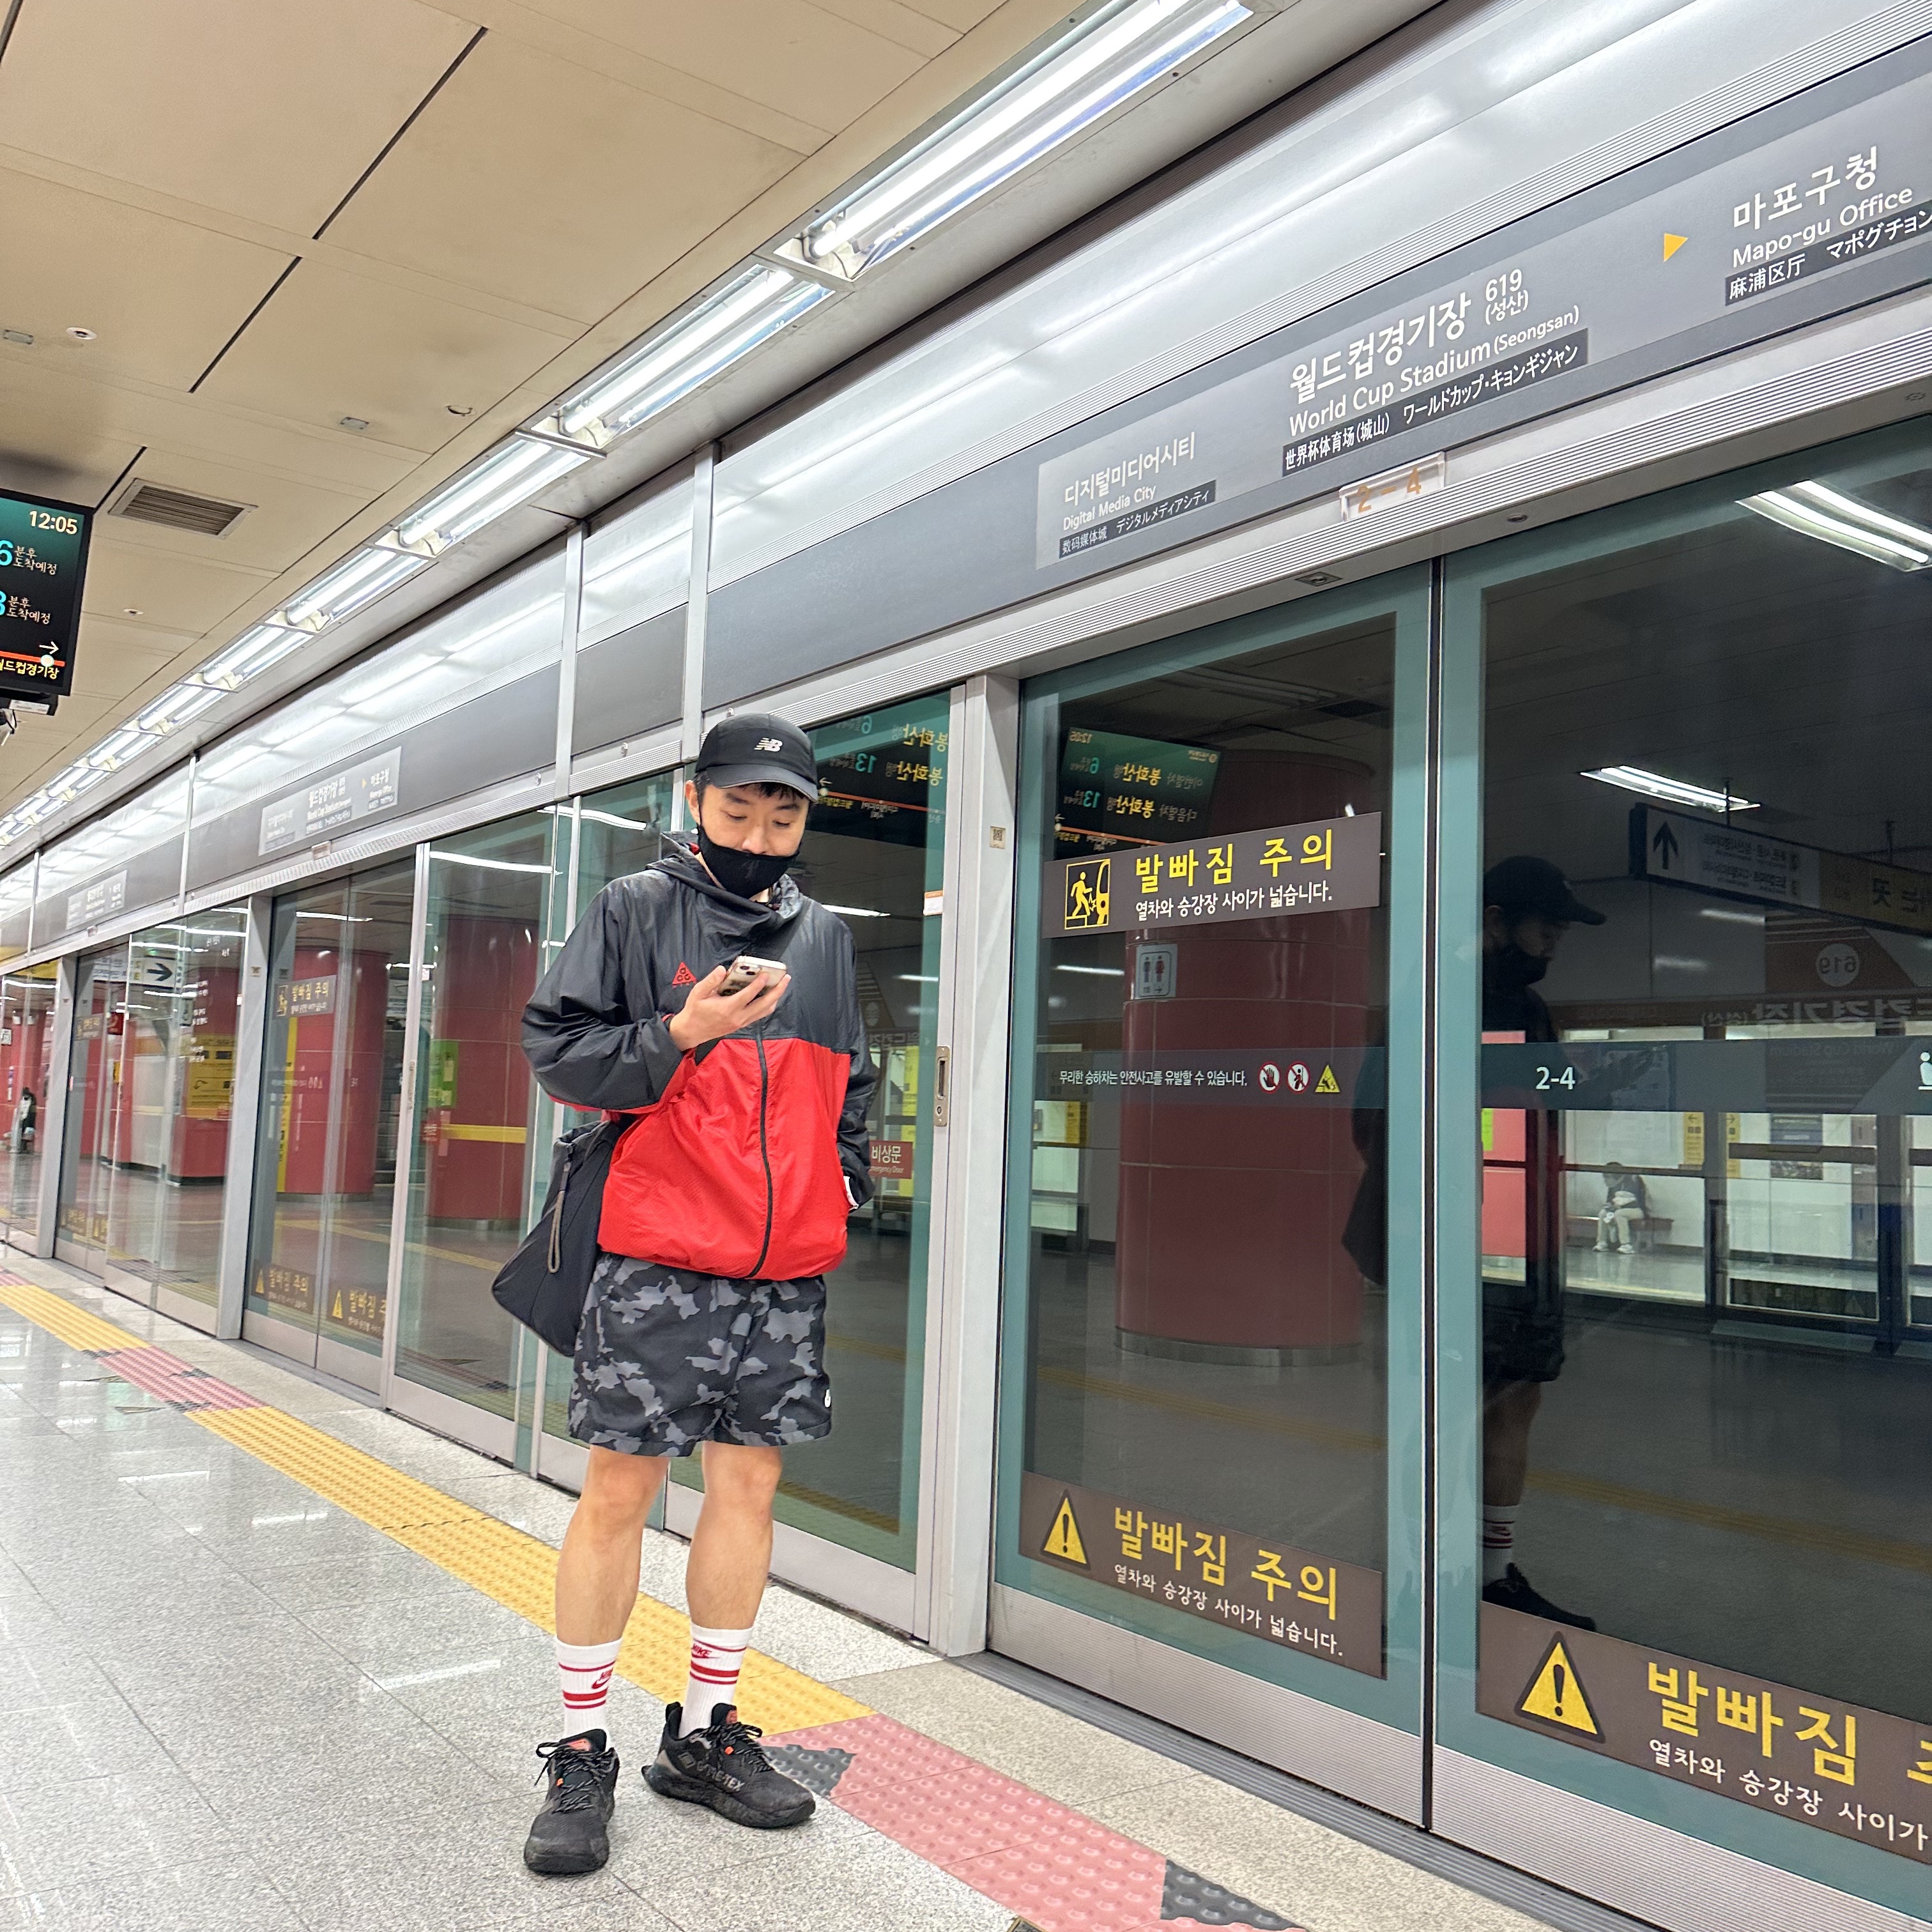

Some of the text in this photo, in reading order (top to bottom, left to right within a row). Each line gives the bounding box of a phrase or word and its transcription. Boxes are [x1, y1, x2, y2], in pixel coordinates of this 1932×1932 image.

[1733, 146, 1878, 230] 마포구청
[1733, 187, 1913, 268] Mapo-gu Office
[1485, 268, 1523, 302] 619
[1729, 253, 1806, 300] 麻浦区厅
[1484, 289, 1529, 325] (성산)
[1289, 291, 1473, 405] 월드컵경기장
[1289, 392, 1347, 437] World
[1353, 381, 1394, 408] Cup
[1400, 341, 1491, 393] Stadium
[1064, 431, 1195, 507] 디지털미디어시티
[29, 510, 77, 534] 12:05
[1062, 485, 1157, 532] Digital Media City
[13, 556, 58, 576] 도착예정
[6, 607, 51, 624] 도착예정
[1135, 828, 1333, 894] 발빠짐 주의
[1135, 879, 1333, 921] 열차와 승강장 사이가 넓습니다.
[1059, 1070, 1248, 1086] 무리한 승하차는 안전사고를 유발할 수 있습니다.
[1535, 1066, 1575, 1091] 2-4
[871, 1144, 902, 1163] 비상문
[1114, 1506, 1337, 1621] 발빠짐 주의
[1114, 1563, 1344, 1657] 열차와 승강장 사이가 넓습니다.
[1647, 1661, 1857, 1786] 발빠짐
[1648, 1738, 1929, 1851] 열차와 승강장 사이가
